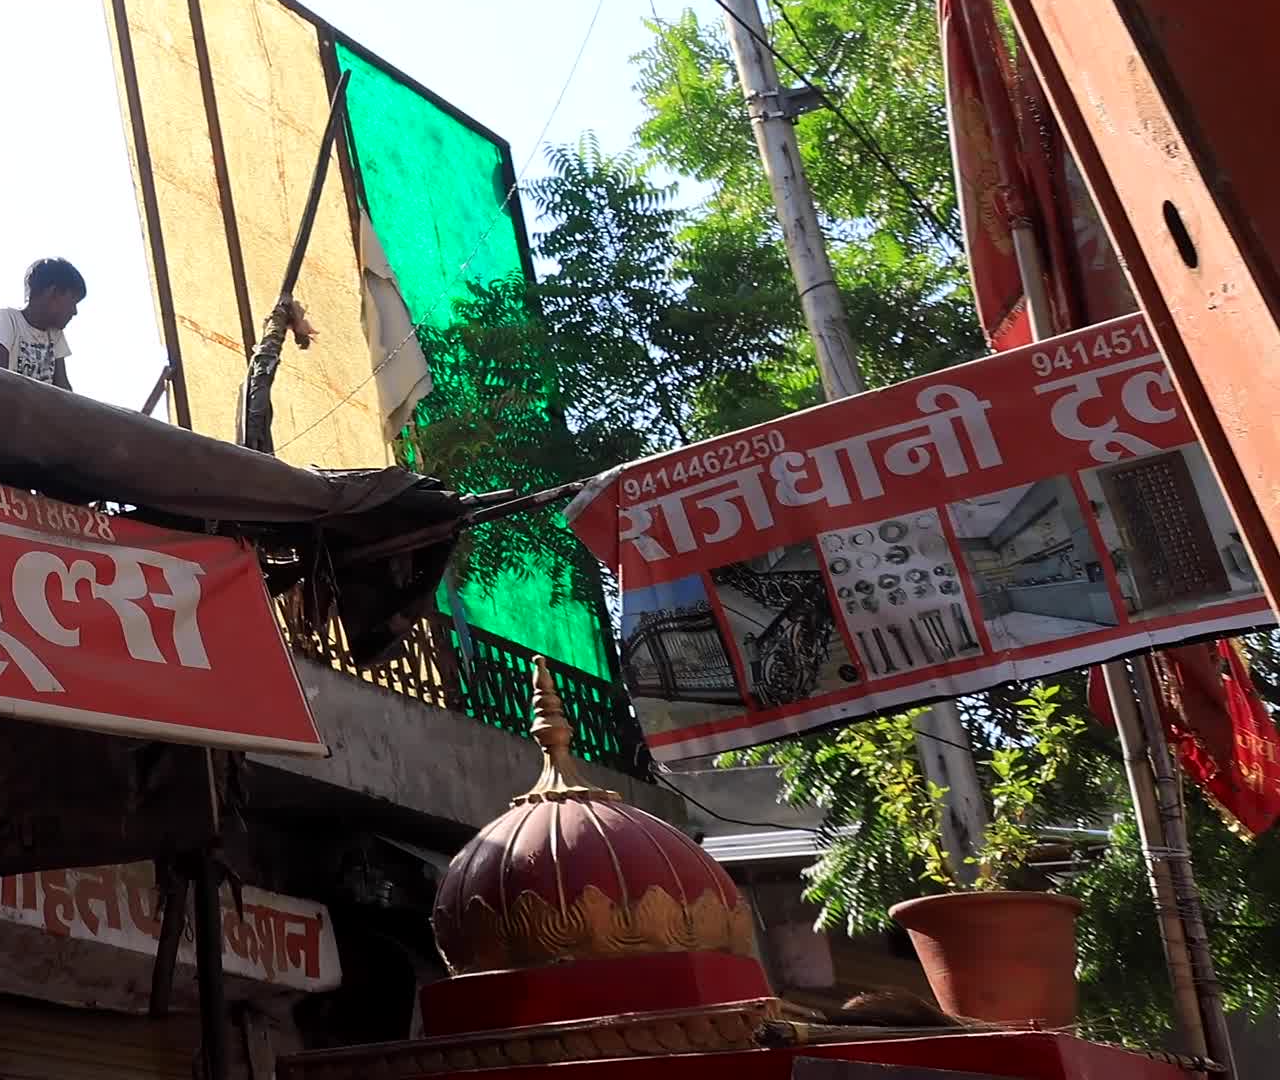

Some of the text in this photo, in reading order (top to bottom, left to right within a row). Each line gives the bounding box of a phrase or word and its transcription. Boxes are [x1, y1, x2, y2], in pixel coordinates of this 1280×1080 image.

[1032, 323, 1150, 378] 941451
[618, 384, 1002, 563] राजधानी
[622, 427, 786, 501] 9414462250
